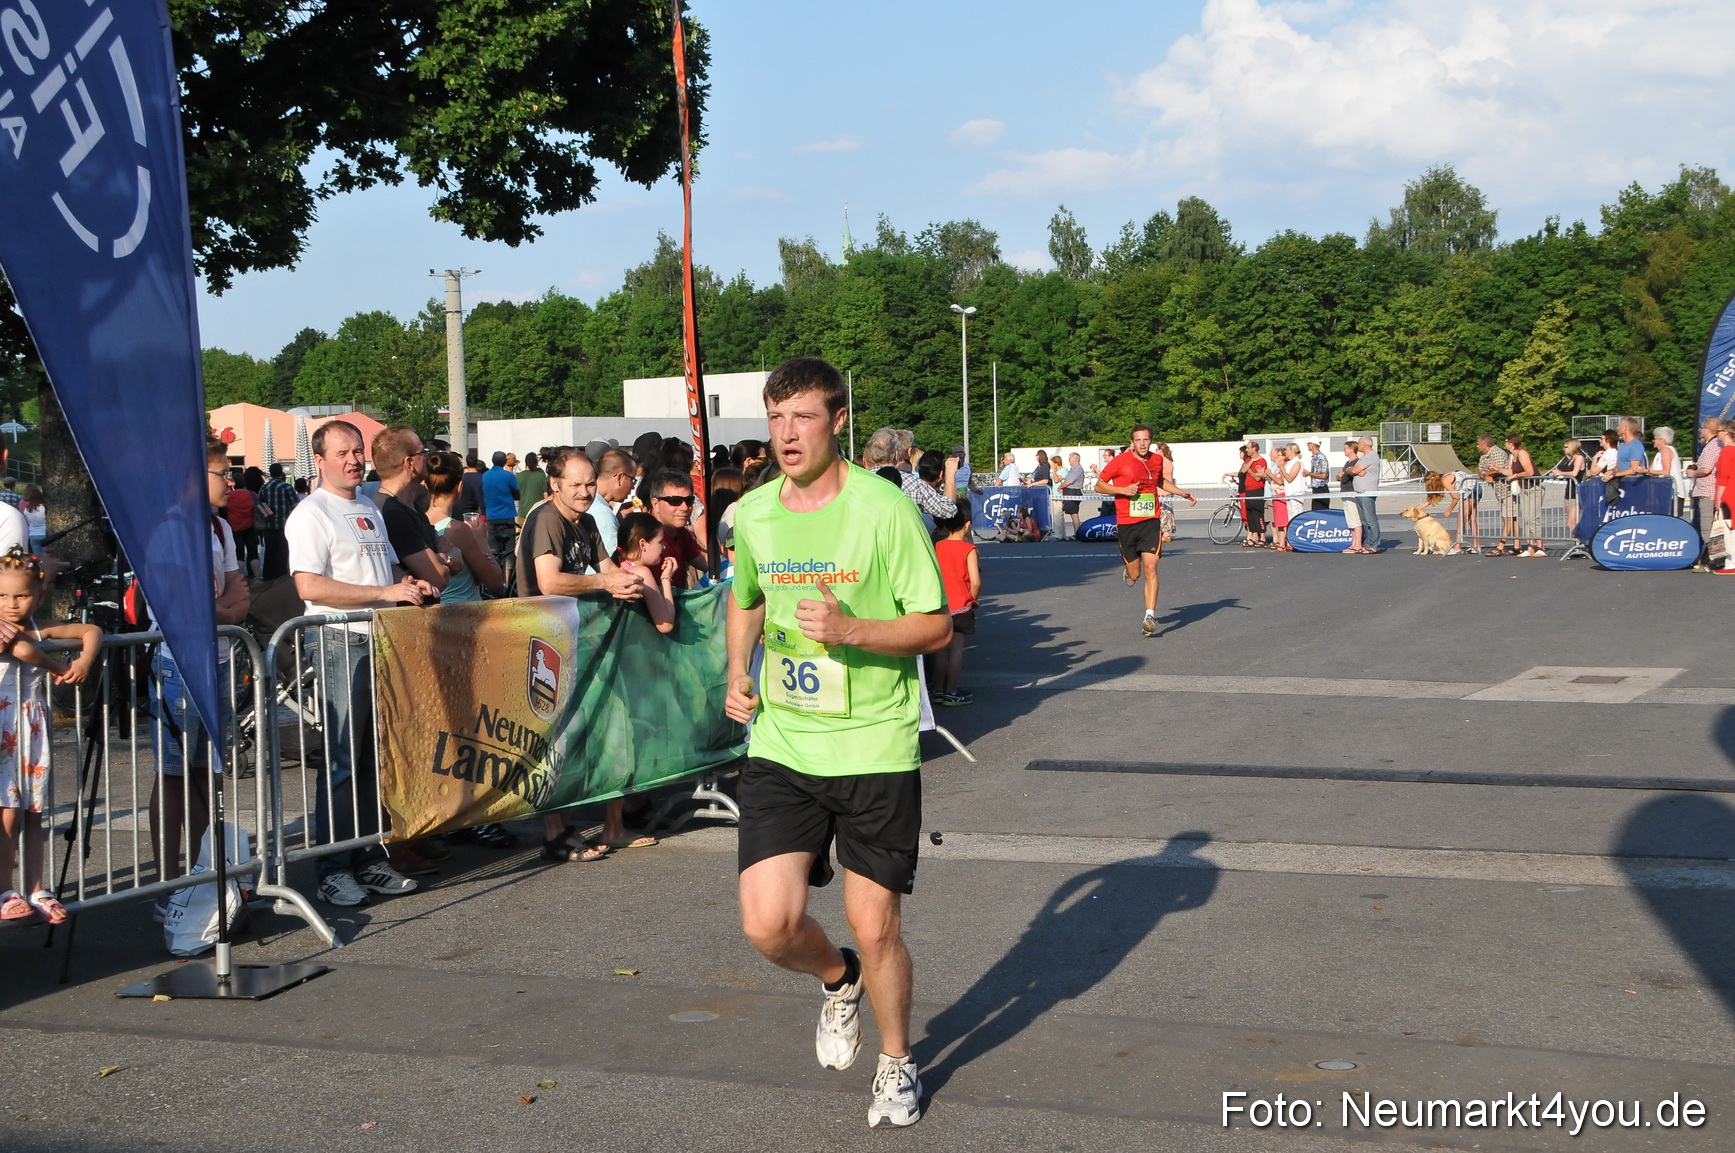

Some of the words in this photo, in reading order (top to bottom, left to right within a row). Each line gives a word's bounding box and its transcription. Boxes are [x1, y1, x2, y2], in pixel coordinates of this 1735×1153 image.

[1705, 353, 1735, 397] Frisc
[1131, 501, 1154, 511] 1349
[1307, 528, 1352, 539] Fische
[1618, 538, 1688, 552] Fischer
[1625, 551, 1683, 559] AUTOMOBILE
[758, 558, 836, 574] autoladen
[771, 569, 860, 584] neumarkt
[781, 657, 820, 694] 36
[534, 697, 550, 714] 1628
